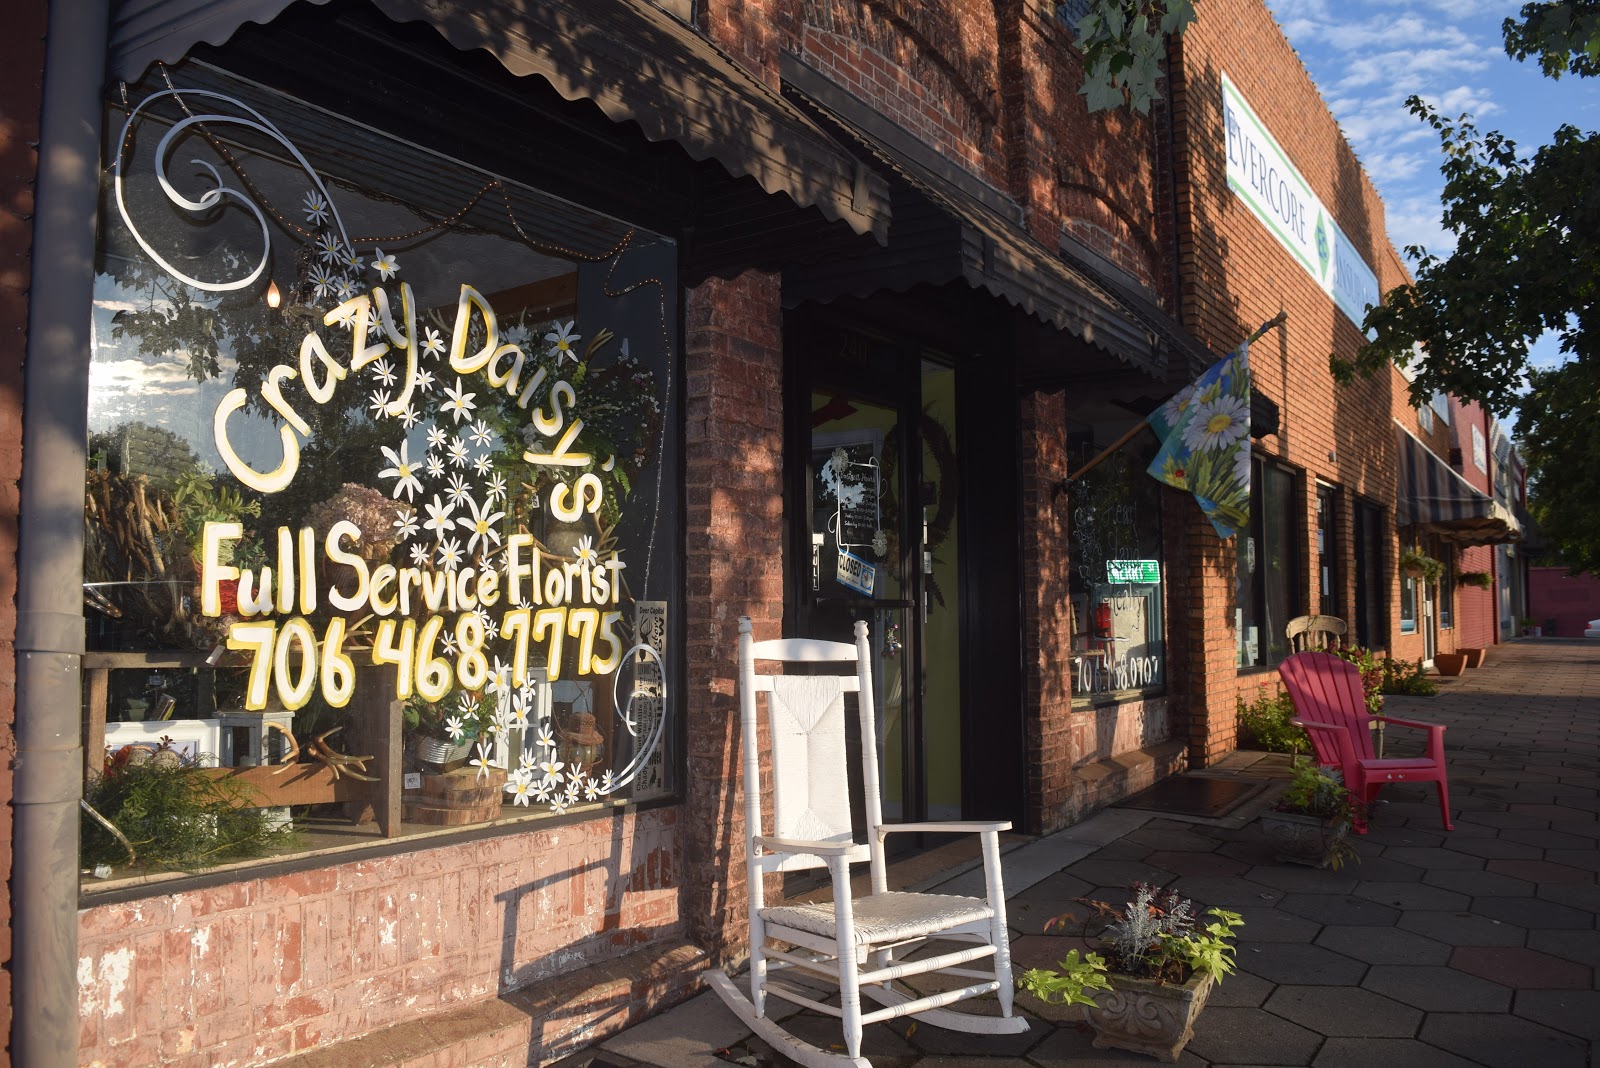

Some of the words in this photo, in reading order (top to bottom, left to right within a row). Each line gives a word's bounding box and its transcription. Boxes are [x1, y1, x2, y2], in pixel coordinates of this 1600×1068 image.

[1226, 103, 1307, 246] EVERCORE
[213, 282, 418, 494] Crazy
[449, 283, 616, 523] Daisy's
[202, 521, 317, 617] Full
[325, 519, 501, 617] Service
[507, 533, 626, 606] Florist
[650, 606, 665, 615] Capital
[838, 553, 862, 578] CLOSED
[226, 615, 357, 711] 706
[372, 611, 490, 703] 468
[499, 606, 624, 690] 7775
[650, 616, 659, 678] Hilsboro
